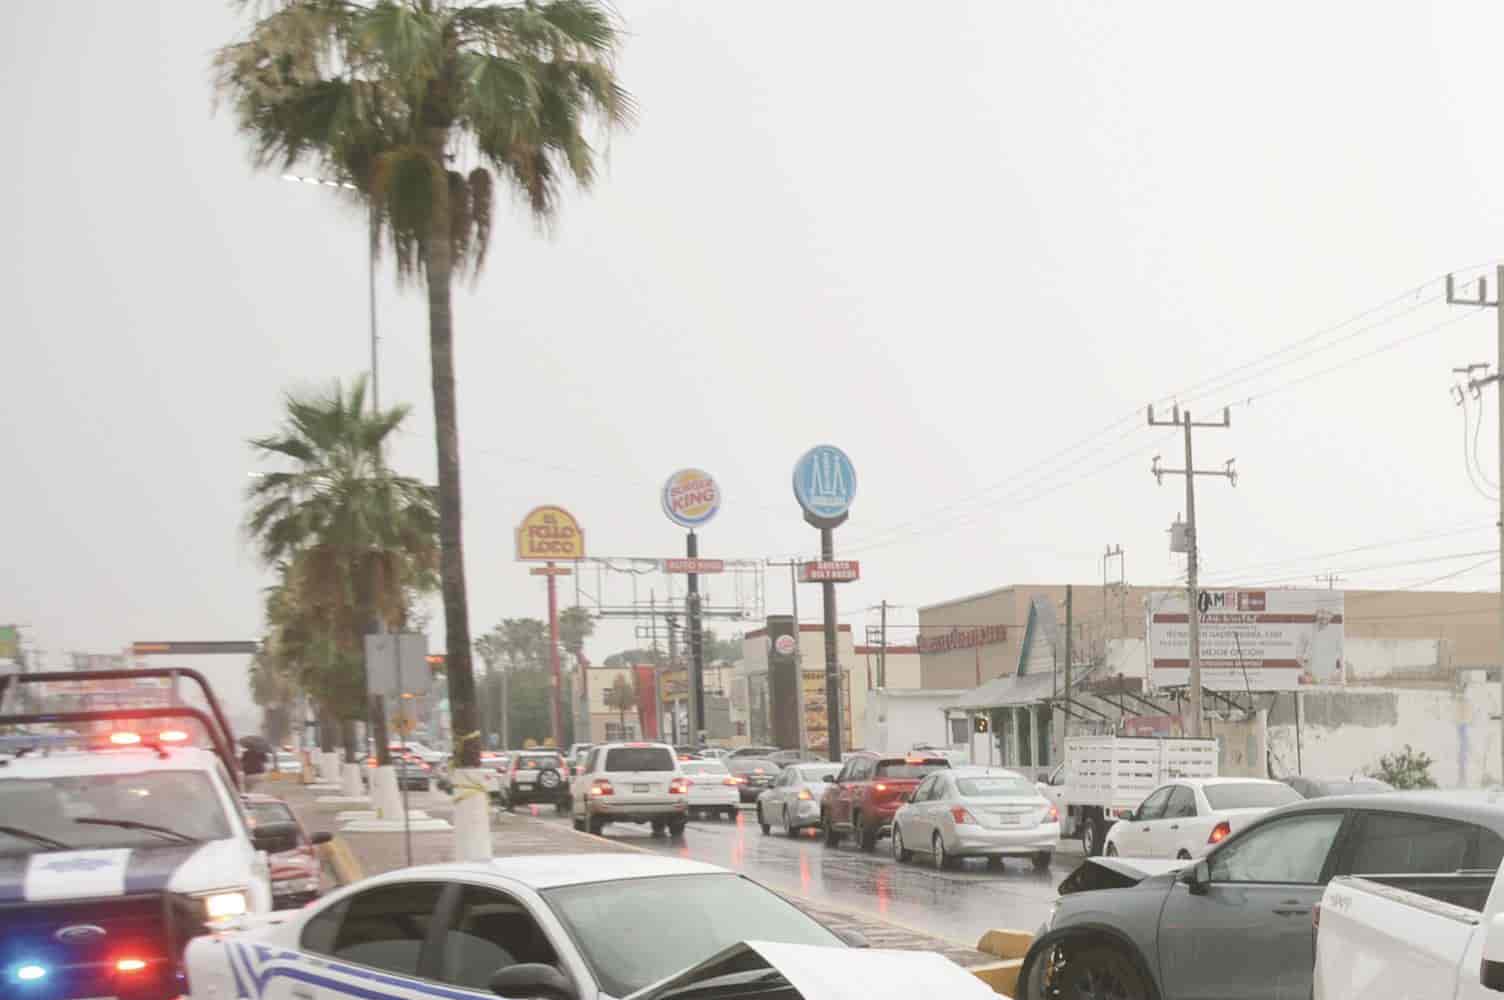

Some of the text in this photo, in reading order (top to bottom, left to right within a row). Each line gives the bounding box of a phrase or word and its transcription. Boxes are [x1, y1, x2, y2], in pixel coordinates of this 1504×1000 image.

[671, 488, 715, 512] KING
[528, 526, 575, 540] POLLO
[528, 540, 575, 553] LOCO
